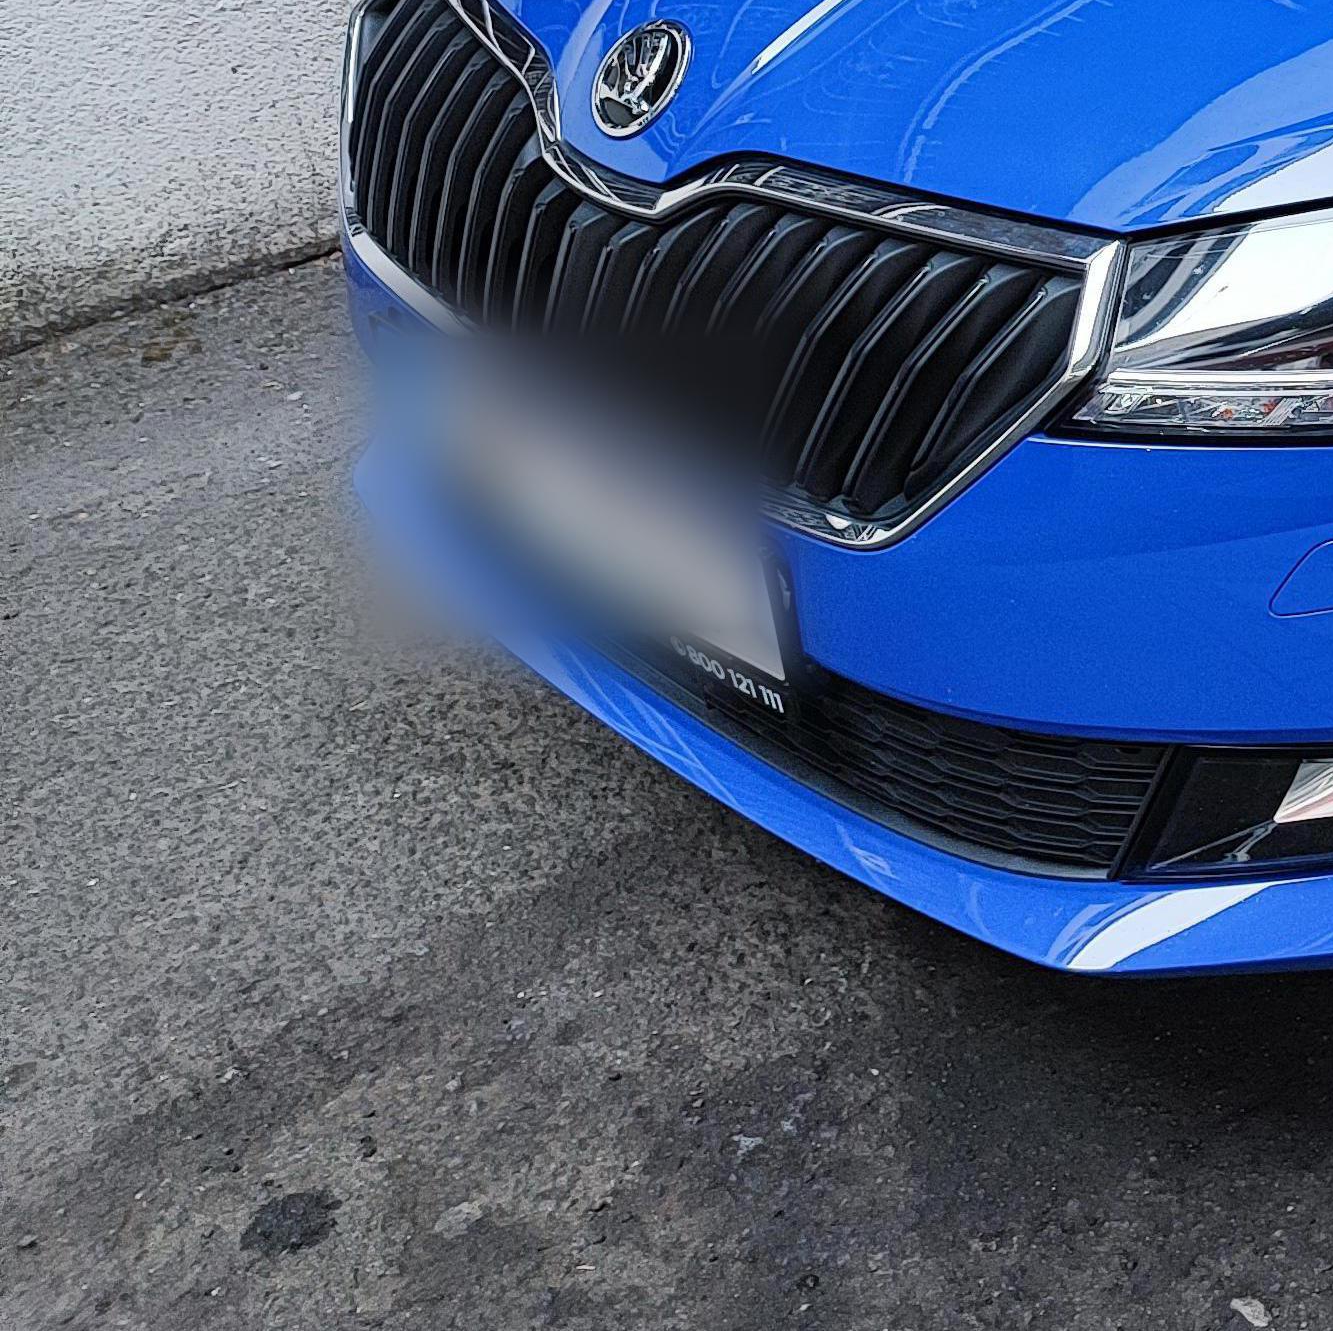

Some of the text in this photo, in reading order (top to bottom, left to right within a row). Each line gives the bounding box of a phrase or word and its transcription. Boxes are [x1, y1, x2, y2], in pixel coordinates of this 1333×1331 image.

[687, 645, 785, 714] 800 121 111
